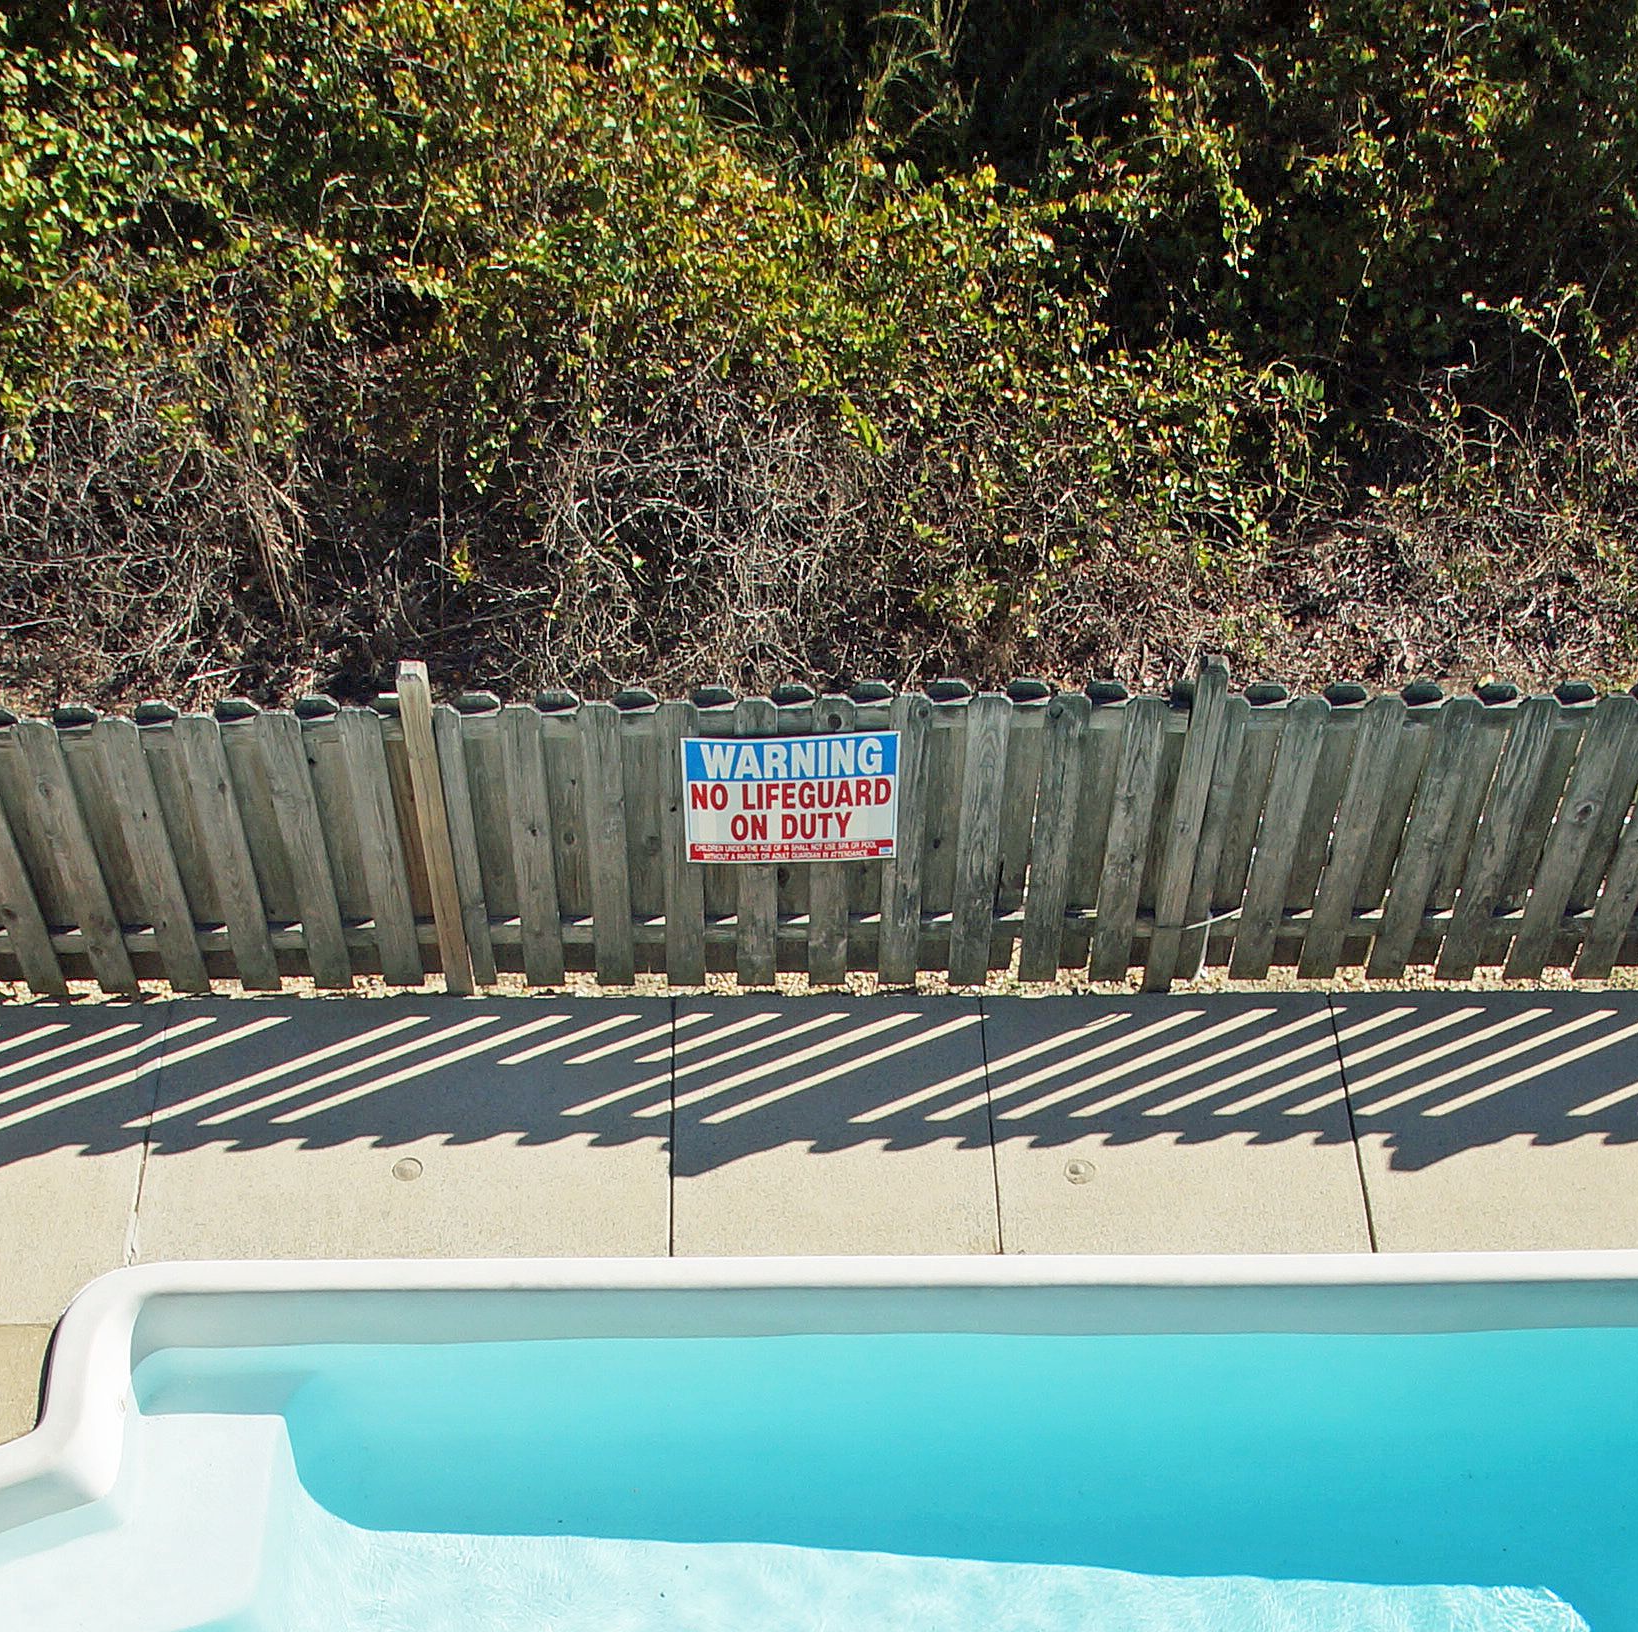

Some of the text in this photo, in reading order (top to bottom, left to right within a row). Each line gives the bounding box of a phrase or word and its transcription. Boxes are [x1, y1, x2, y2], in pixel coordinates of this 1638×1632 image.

[699, 737, 883, 780] WARNING
[690, 778, 892, 811] NO LIFEGUARD
[730, 812, 853, 841] ON DUTY
[695, 844, 724, 852] CHILDREN
[725, 844, 745, 852] UNDER
[746, 844, 759, 852] THE
[760, 844, 772, 852] AGE
[791, 843, 809, 851] SHALL
[811, 843, 822, 851] NOT
[824, 842, 836, 850] USE
[850, 841, 860, 849] OR
[703, 852, 730, 860] WITHOUT
[737, 852, 759, 860] PARENT
[760, 852, 770, 860] OR
[791, 851, 821, 859] GUARDIAN
